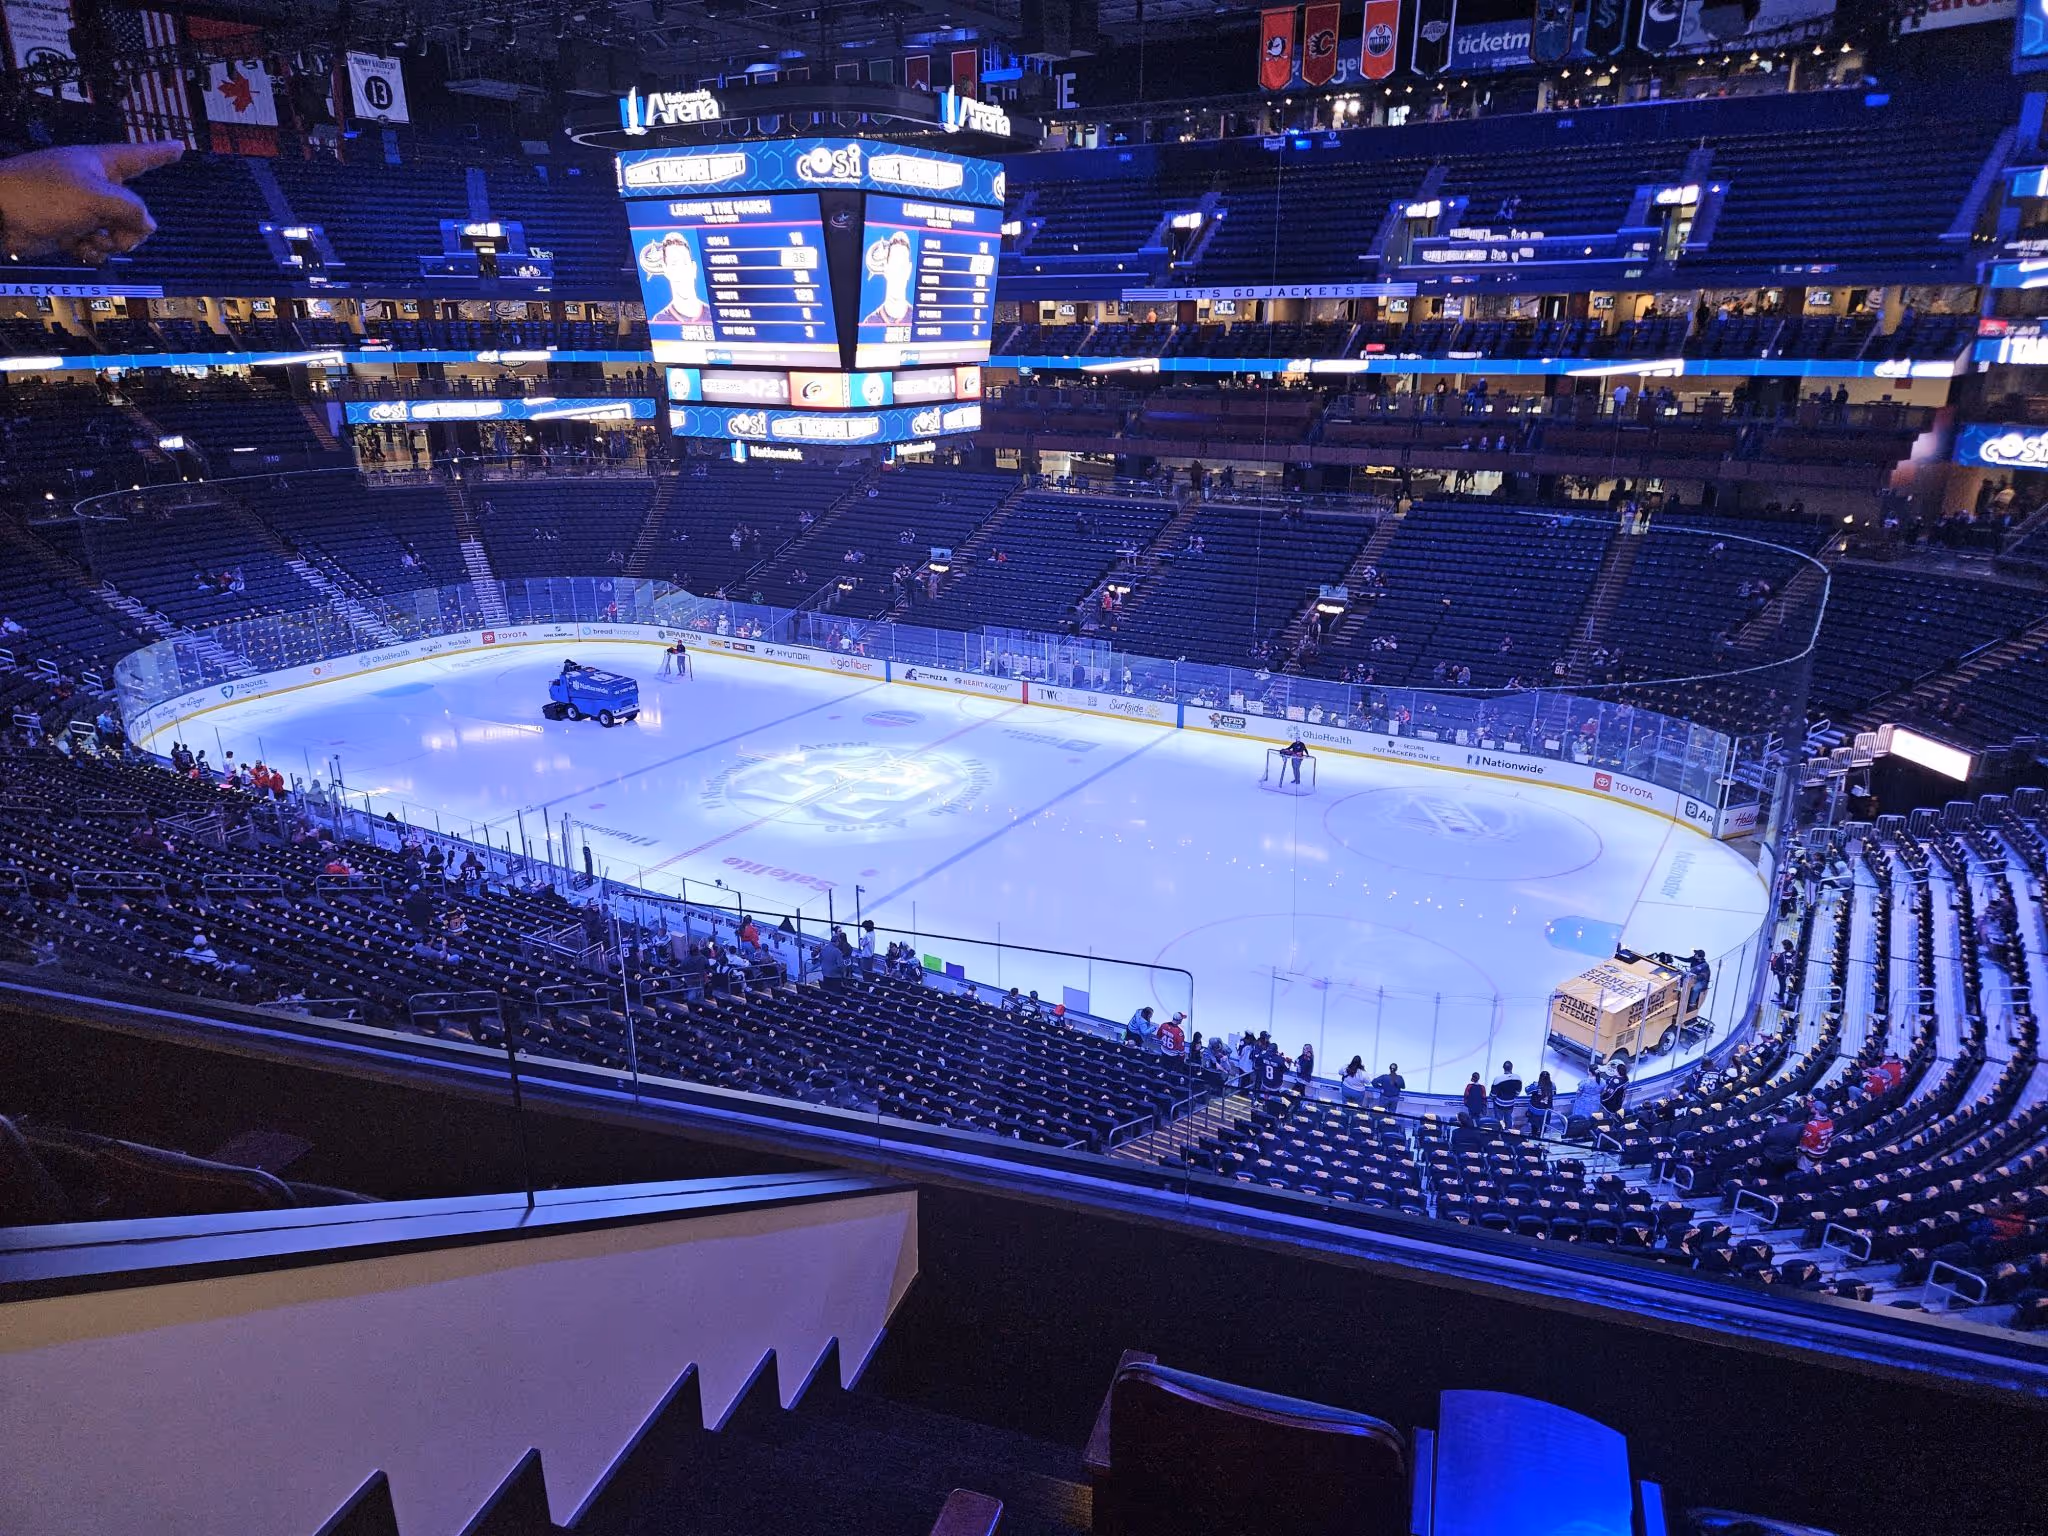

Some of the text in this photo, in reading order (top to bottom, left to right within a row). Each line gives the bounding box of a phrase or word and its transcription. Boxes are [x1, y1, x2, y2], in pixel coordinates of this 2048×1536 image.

[371, 80, 388, 104] 13
[645, 92, 721, 126] Arena
[958, 96, 1011, 136] Arena
[713, 201, 734, 215] THE
[0, 286, 101, 295] JACKETS
[1173, 286, 1355, 298] LET'S GO JACKETS
[750, 445, 803, 461] Nationwide
[497, 631, 528, 640] TOYOTA
[593, 628, 613, 636] bread
[666, 630, 702, 641] SPARTAN
[372, 649, 411, 663] OhioHealth
[777, 649, 811, 662] HYUNDAI
[237, 680, 268, 690] FANDUEL
[930, 674, 948, 682] PIZZA
[963, 679, 983, 688] HEART
[1038, 688, 1063, 702] TWC
[1109, 699, 1144, 713] Surfside
[1222, 716, 1244, 726] APEX
[1302, 730, 1352, 745] OhioHealth
[1372, 746, 1441, 762] PUT HACKERS ON ICE
[1482, 756, 1544, 774] Nationwide
[1615, 782, 1653, 801] TOYOTA
[722, 856, 839, 891] Safelite
[1579, 971, 1637, 1000] STEEMER
[1588, 968, 1647, 994] STANLEY
[1161, 1035, 1175, 1049] 46
[1265, 1065, 1274, 1080] 8
